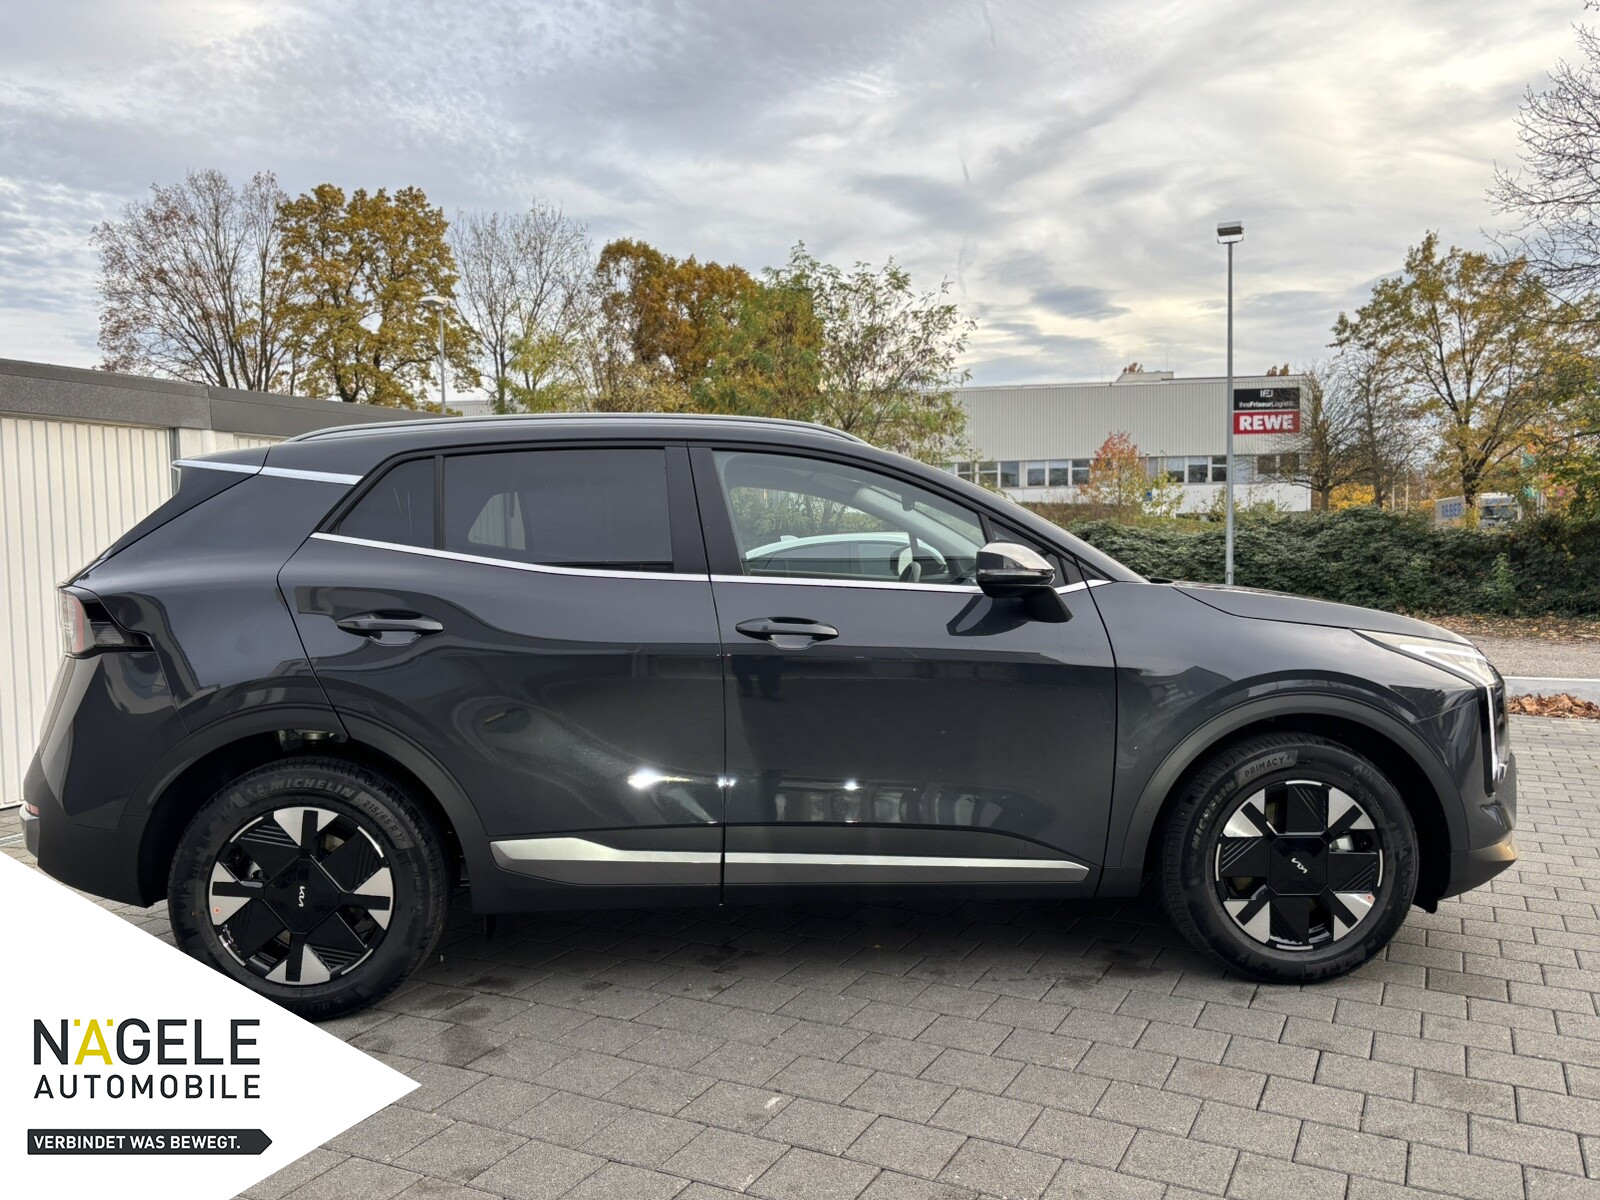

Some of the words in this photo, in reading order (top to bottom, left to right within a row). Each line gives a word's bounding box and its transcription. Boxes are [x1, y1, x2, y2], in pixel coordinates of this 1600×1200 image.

[1239, 414, 1294, 431] REWE
[1244, 756, 1285, 778] PRIMACY
[271, 778, 355, 799] MICHELIN
[362, 800, 391, 827] 215/65
[389, 823, 399, 833] R
[394, 832, 406, 843] 17
[1191, 779, 1237, 850] MICHELIN
